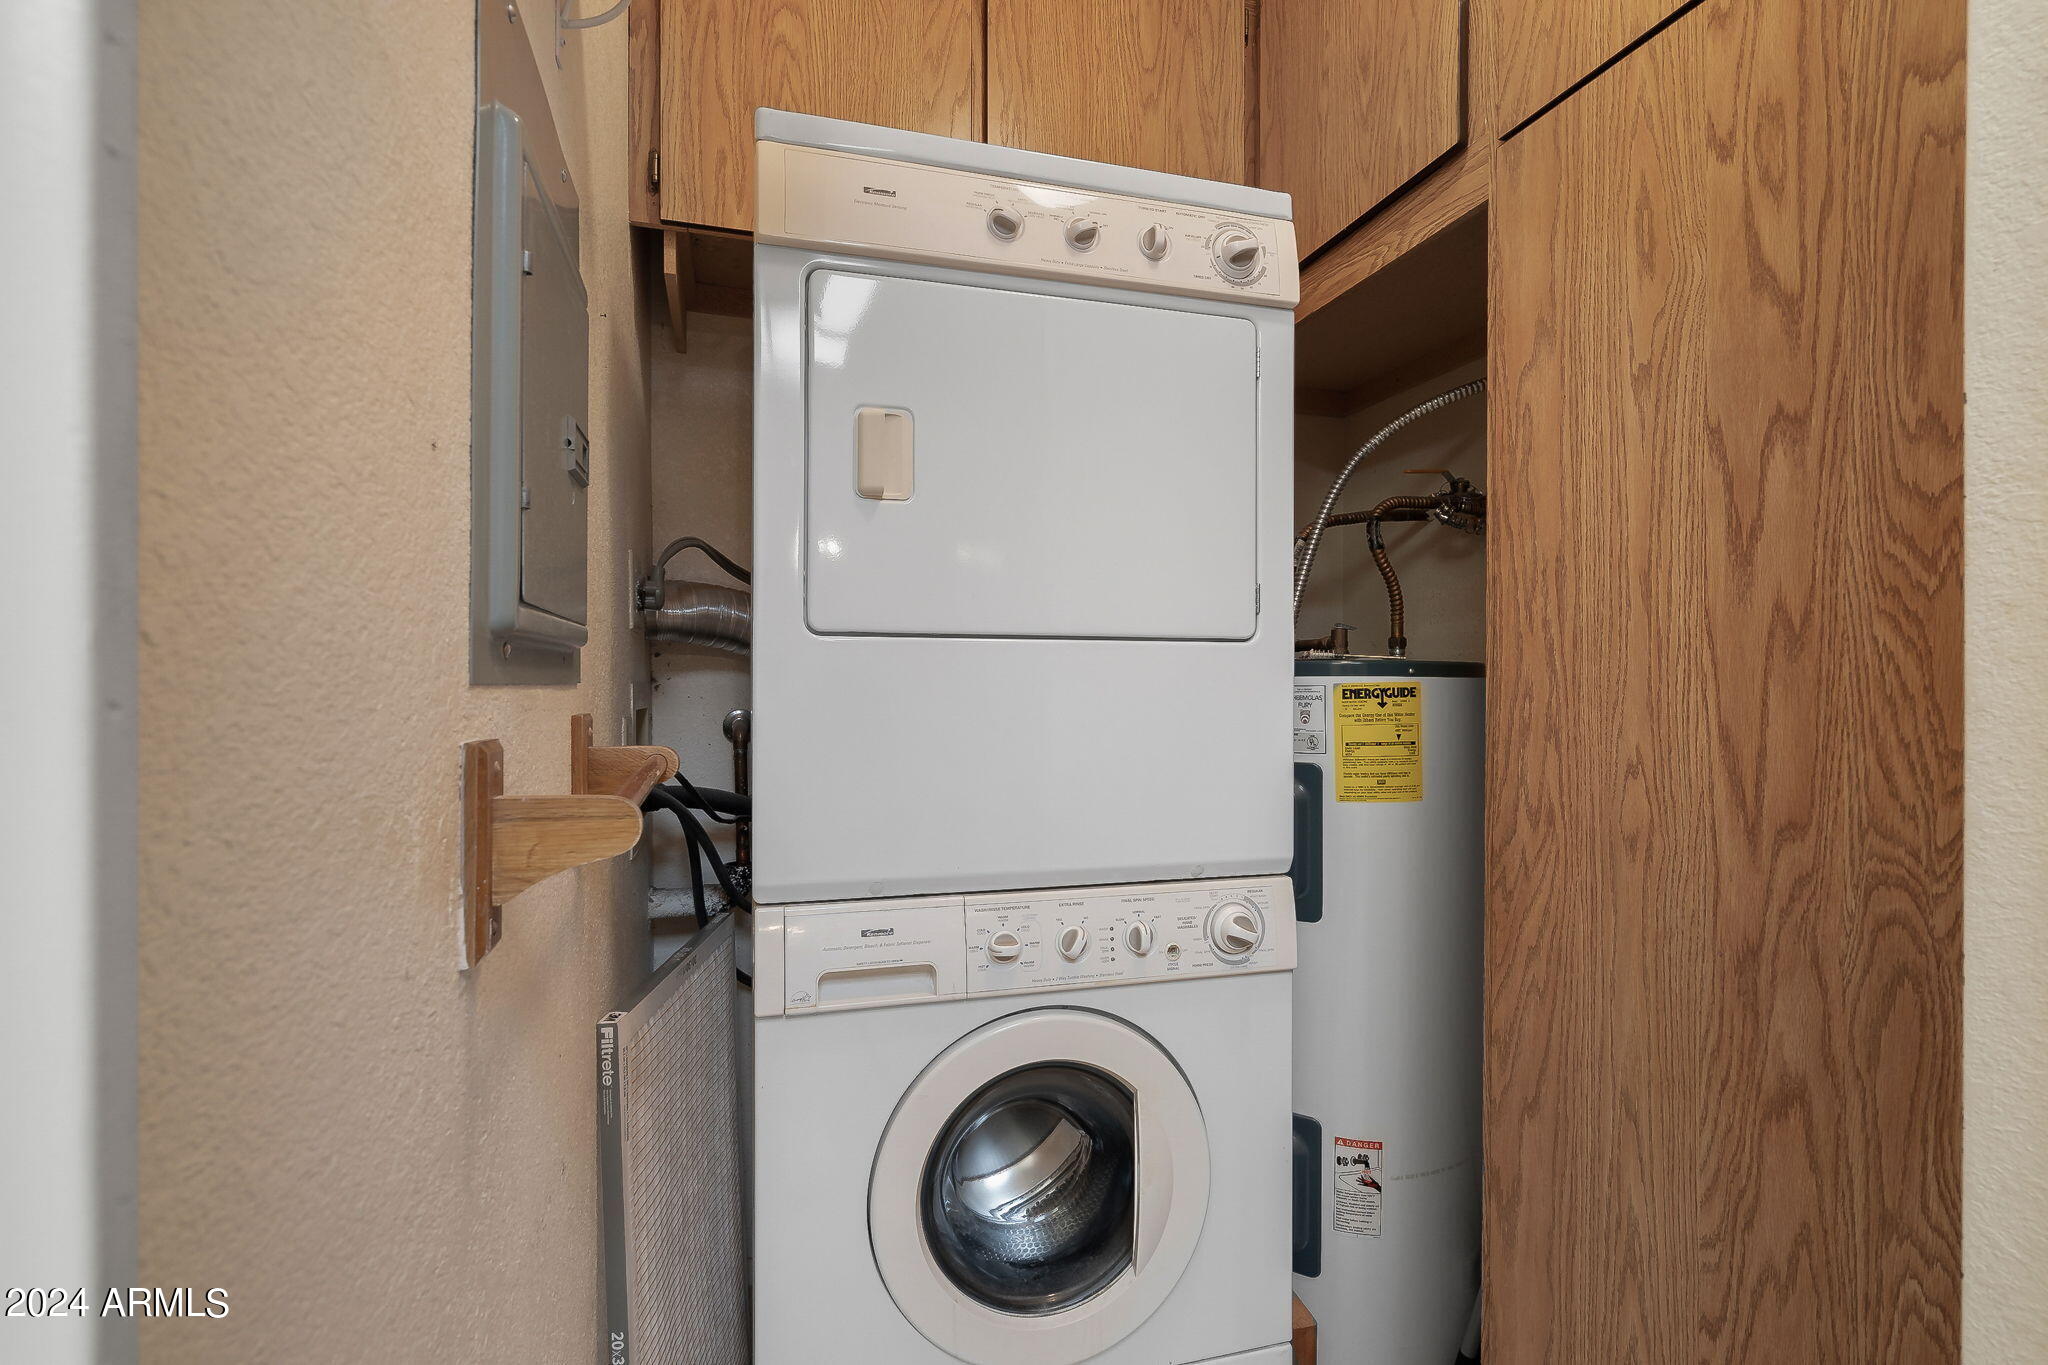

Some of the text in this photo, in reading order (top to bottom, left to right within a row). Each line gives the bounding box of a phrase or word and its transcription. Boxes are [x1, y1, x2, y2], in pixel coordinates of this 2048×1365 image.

[1342, 687, 1417, 700] ENERGYGUIDE
[600, 1027, 615, 1087] Filtrete
[1346, 1140, 1380, 1149] DANGER
